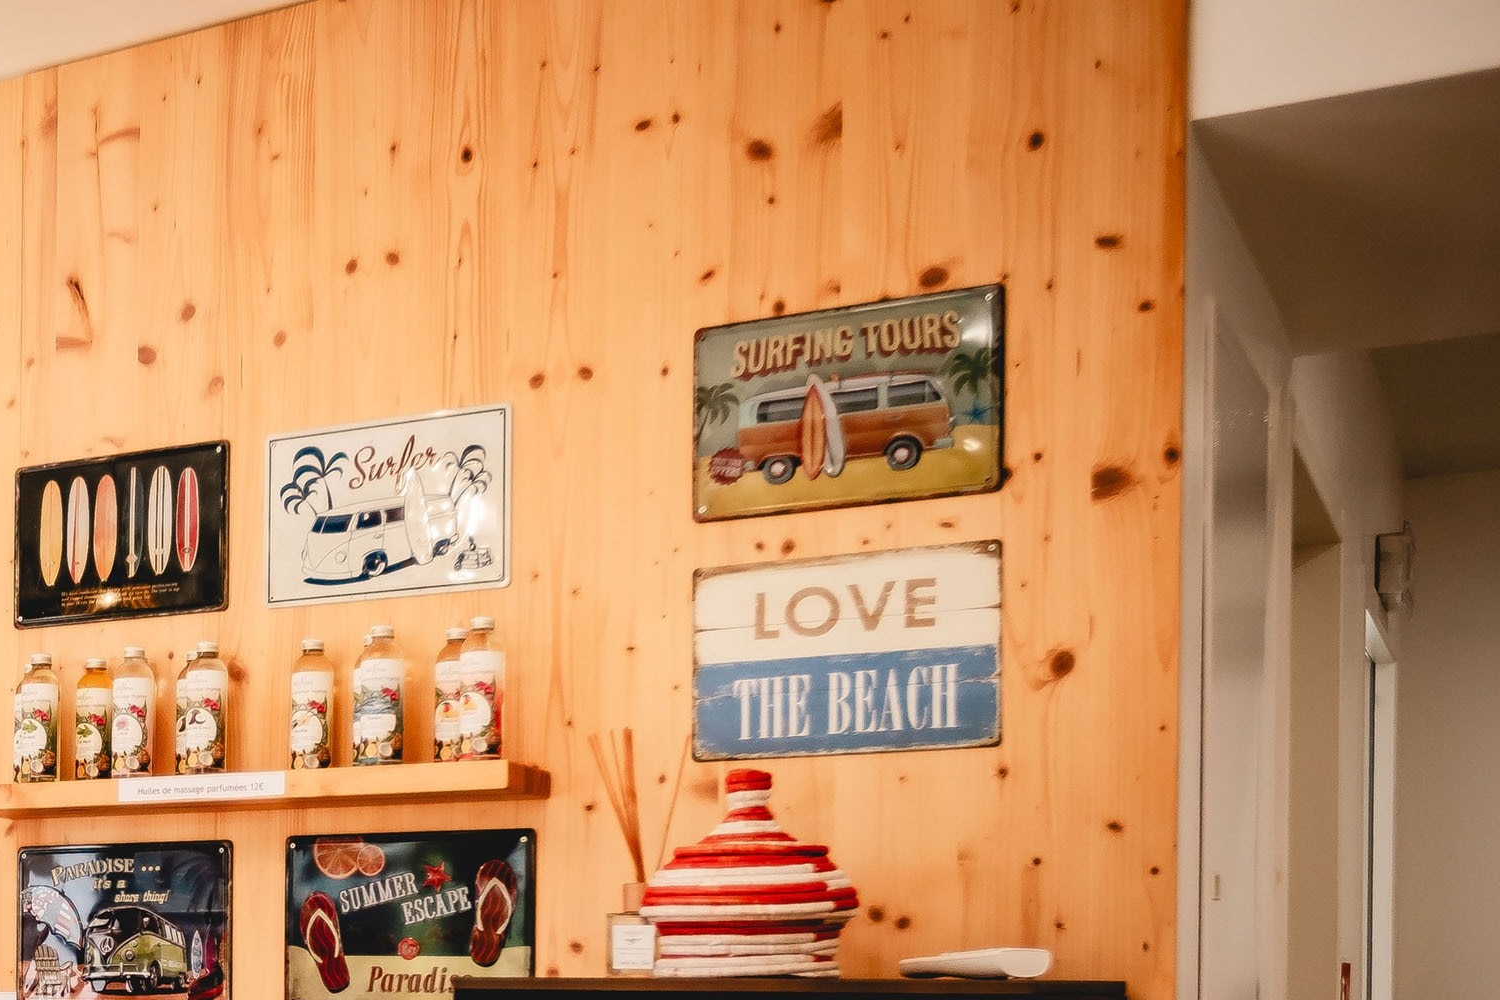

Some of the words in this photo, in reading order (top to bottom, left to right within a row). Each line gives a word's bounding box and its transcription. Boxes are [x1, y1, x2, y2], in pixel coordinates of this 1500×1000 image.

[730, 325, 854, 380] SURFING
[859, 310, 962, 356] TOURS
[349, 434, 438, 493] Surfer
[754, 577, 938, 640] LOVE
[732, 673, 812, 741] THE
[826, 662, 961, 736] BEACH
[138, 787, 160, 795] Huiles
[162, 786, 171, 794] de
[174, 786, 204, 795] massage
[207, 783, 248, 794] parfumées
[250, 782, 264, 791] 12€
[92, 878, 111, 890] it's
[116, 880, 126, 889] a
[142, 890, 170, 905] thing!
[339, 872, 419, 914] SUMMER
[401, 887, 472, 925] ESCAPE
[367, 966, 463, 993] Paradis
